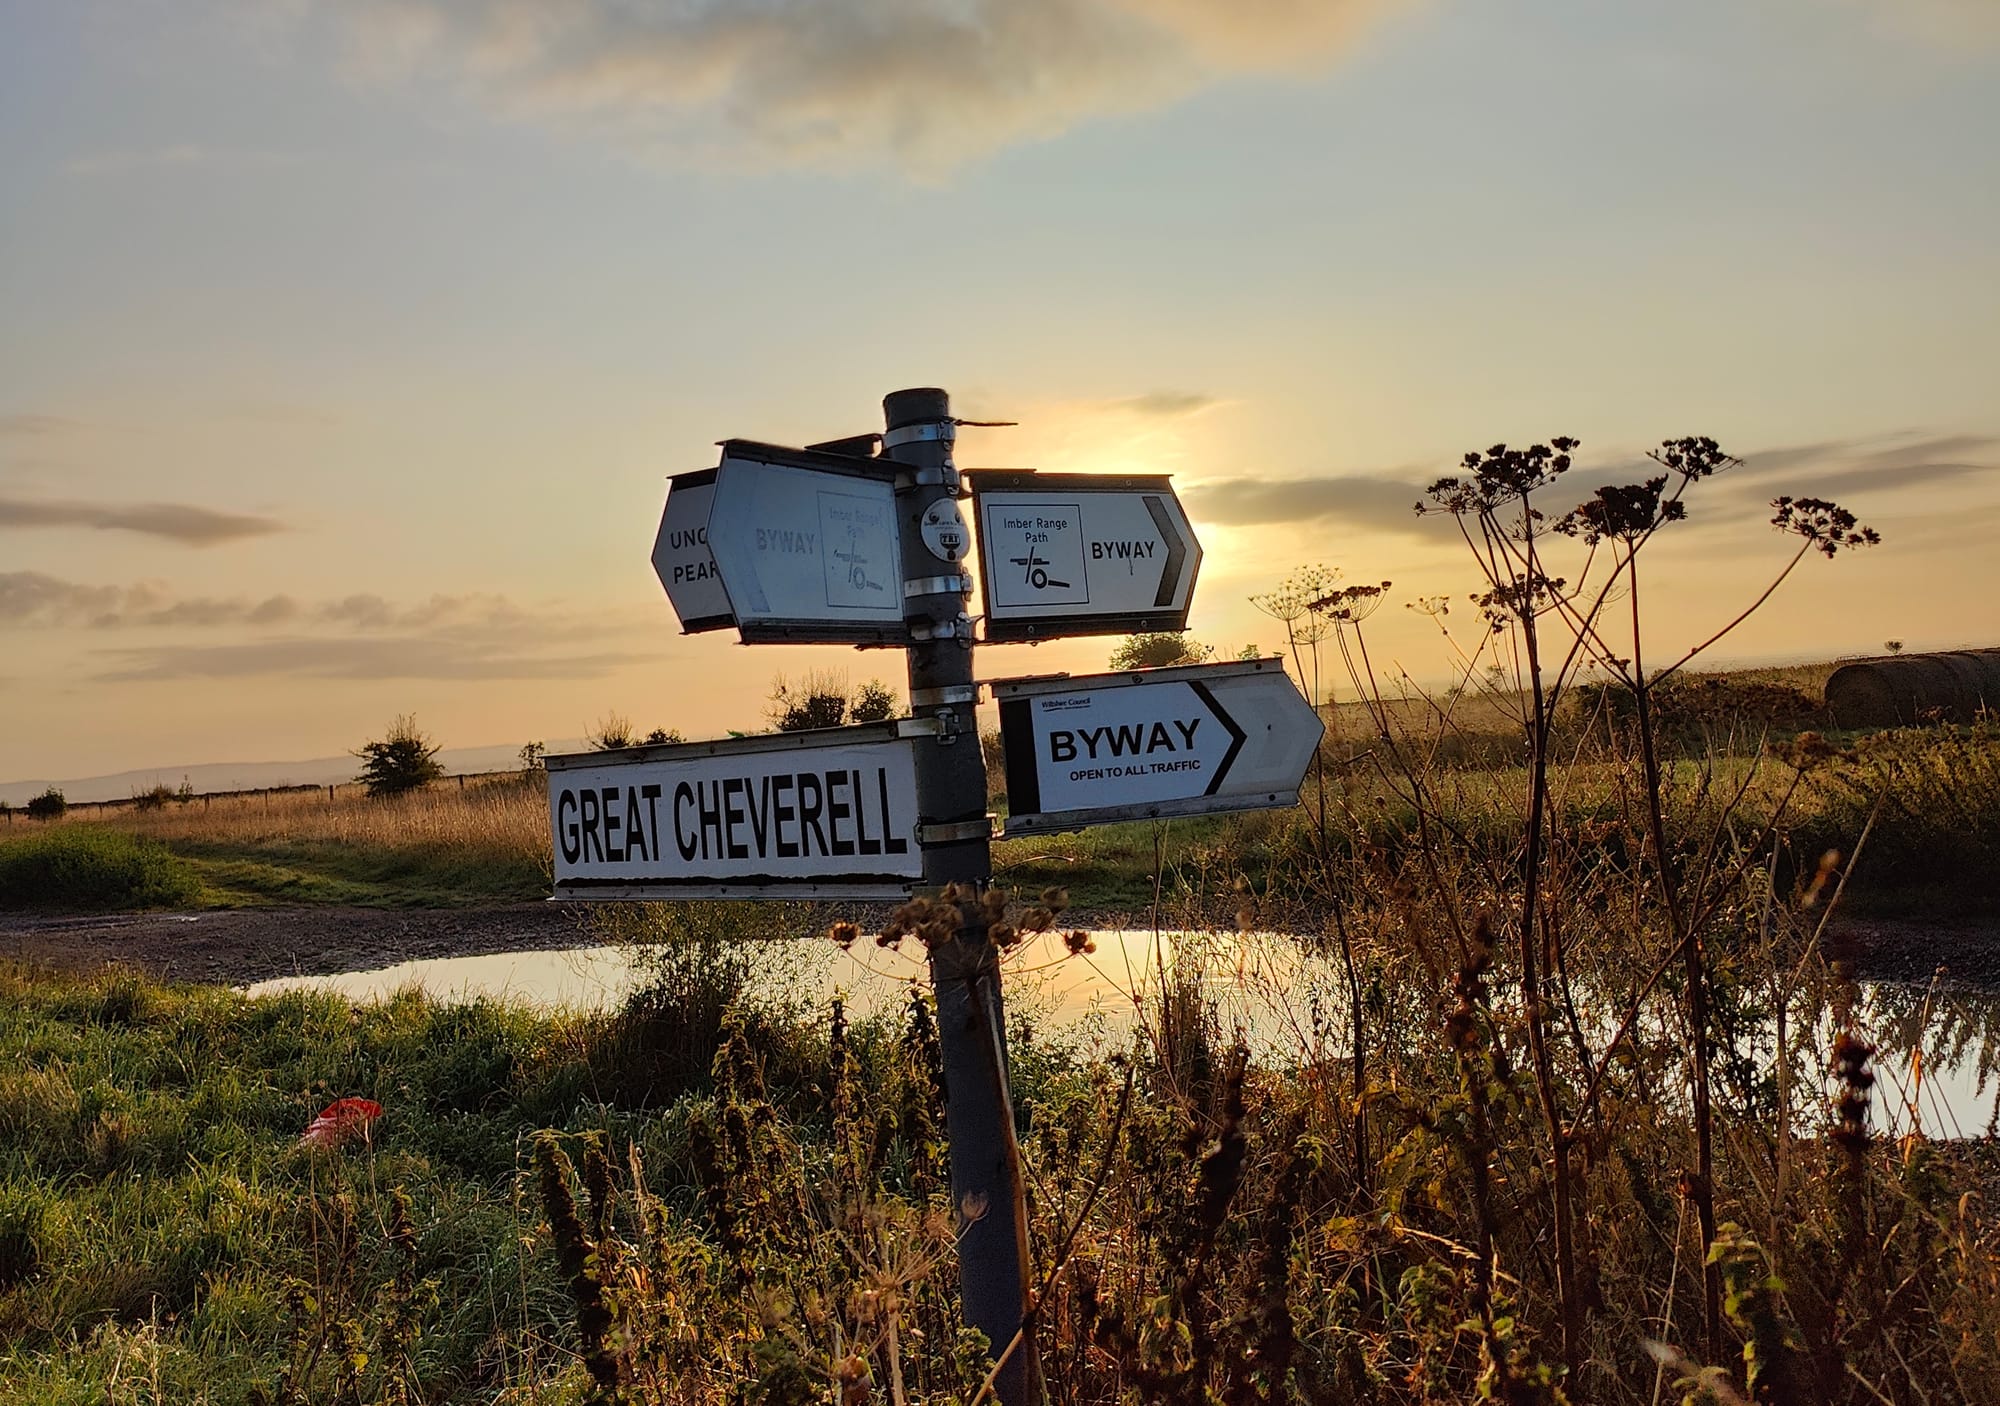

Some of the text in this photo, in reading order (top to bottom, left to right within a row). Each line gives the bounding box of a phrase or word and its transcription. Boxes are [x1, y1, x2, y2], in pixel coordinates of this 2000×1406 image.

[1003, 517, 1067, 530] Imber Range
[756, 527, 815, 554] BYWAY
[1025, 532, 1048, 543] Path
[1092, 541, 1155, 560] BYWAY
[1049, 718, 1200, 763] BYWAY
[1070, 759, 1201, 782] OPEN TO ALL TRAFFIC
[558, 767, 908, 865] GREAT CHEVERELL
